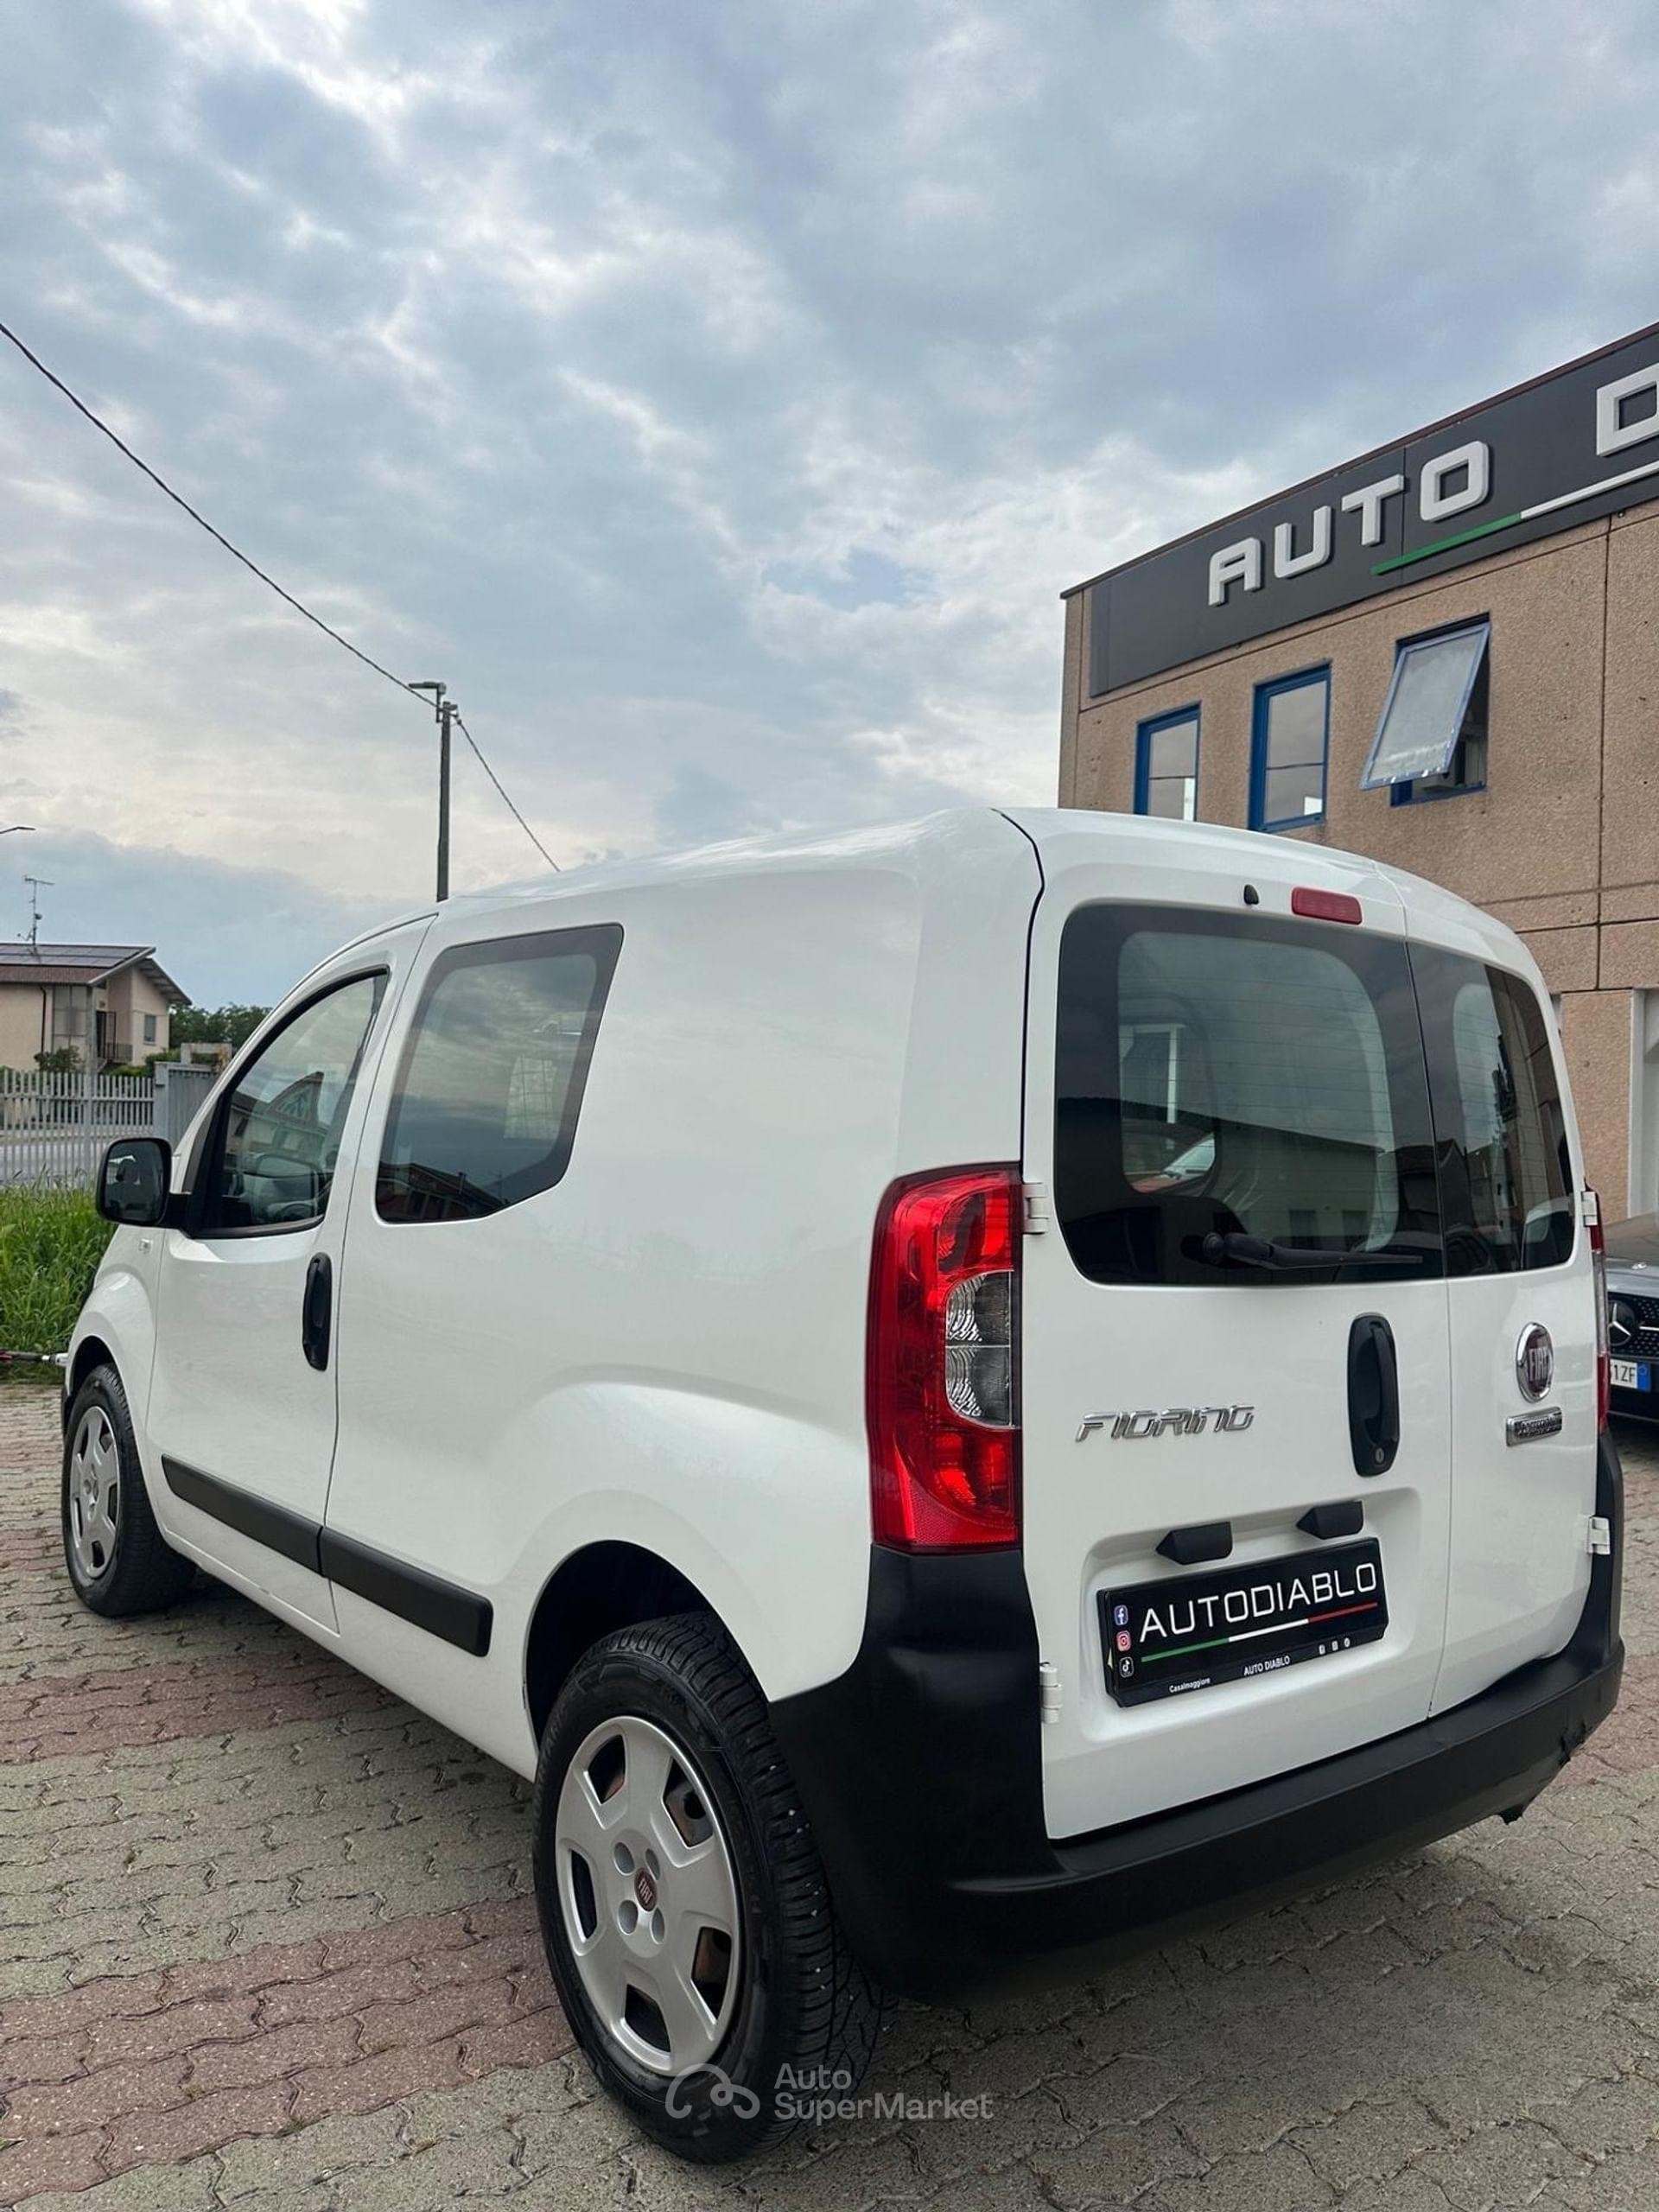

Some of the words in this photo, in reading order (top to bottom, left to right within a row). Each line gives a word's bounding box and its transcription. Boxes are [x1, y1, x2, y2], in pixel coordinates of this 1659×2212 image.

[1208, 441, 1490, 606] AUTO
[1596, 363, 1659, 458] D
[1611, 1364, 1636, 1383] 1ZF
[1075, 1405, 1255, 1442] FIORINO
[1139, 1562, 1376, 1642] AUTODIABLO
[1243, 1662, 1264, 1676] AUTO
[1264, 1656, 1291, 1670] DIABLO
